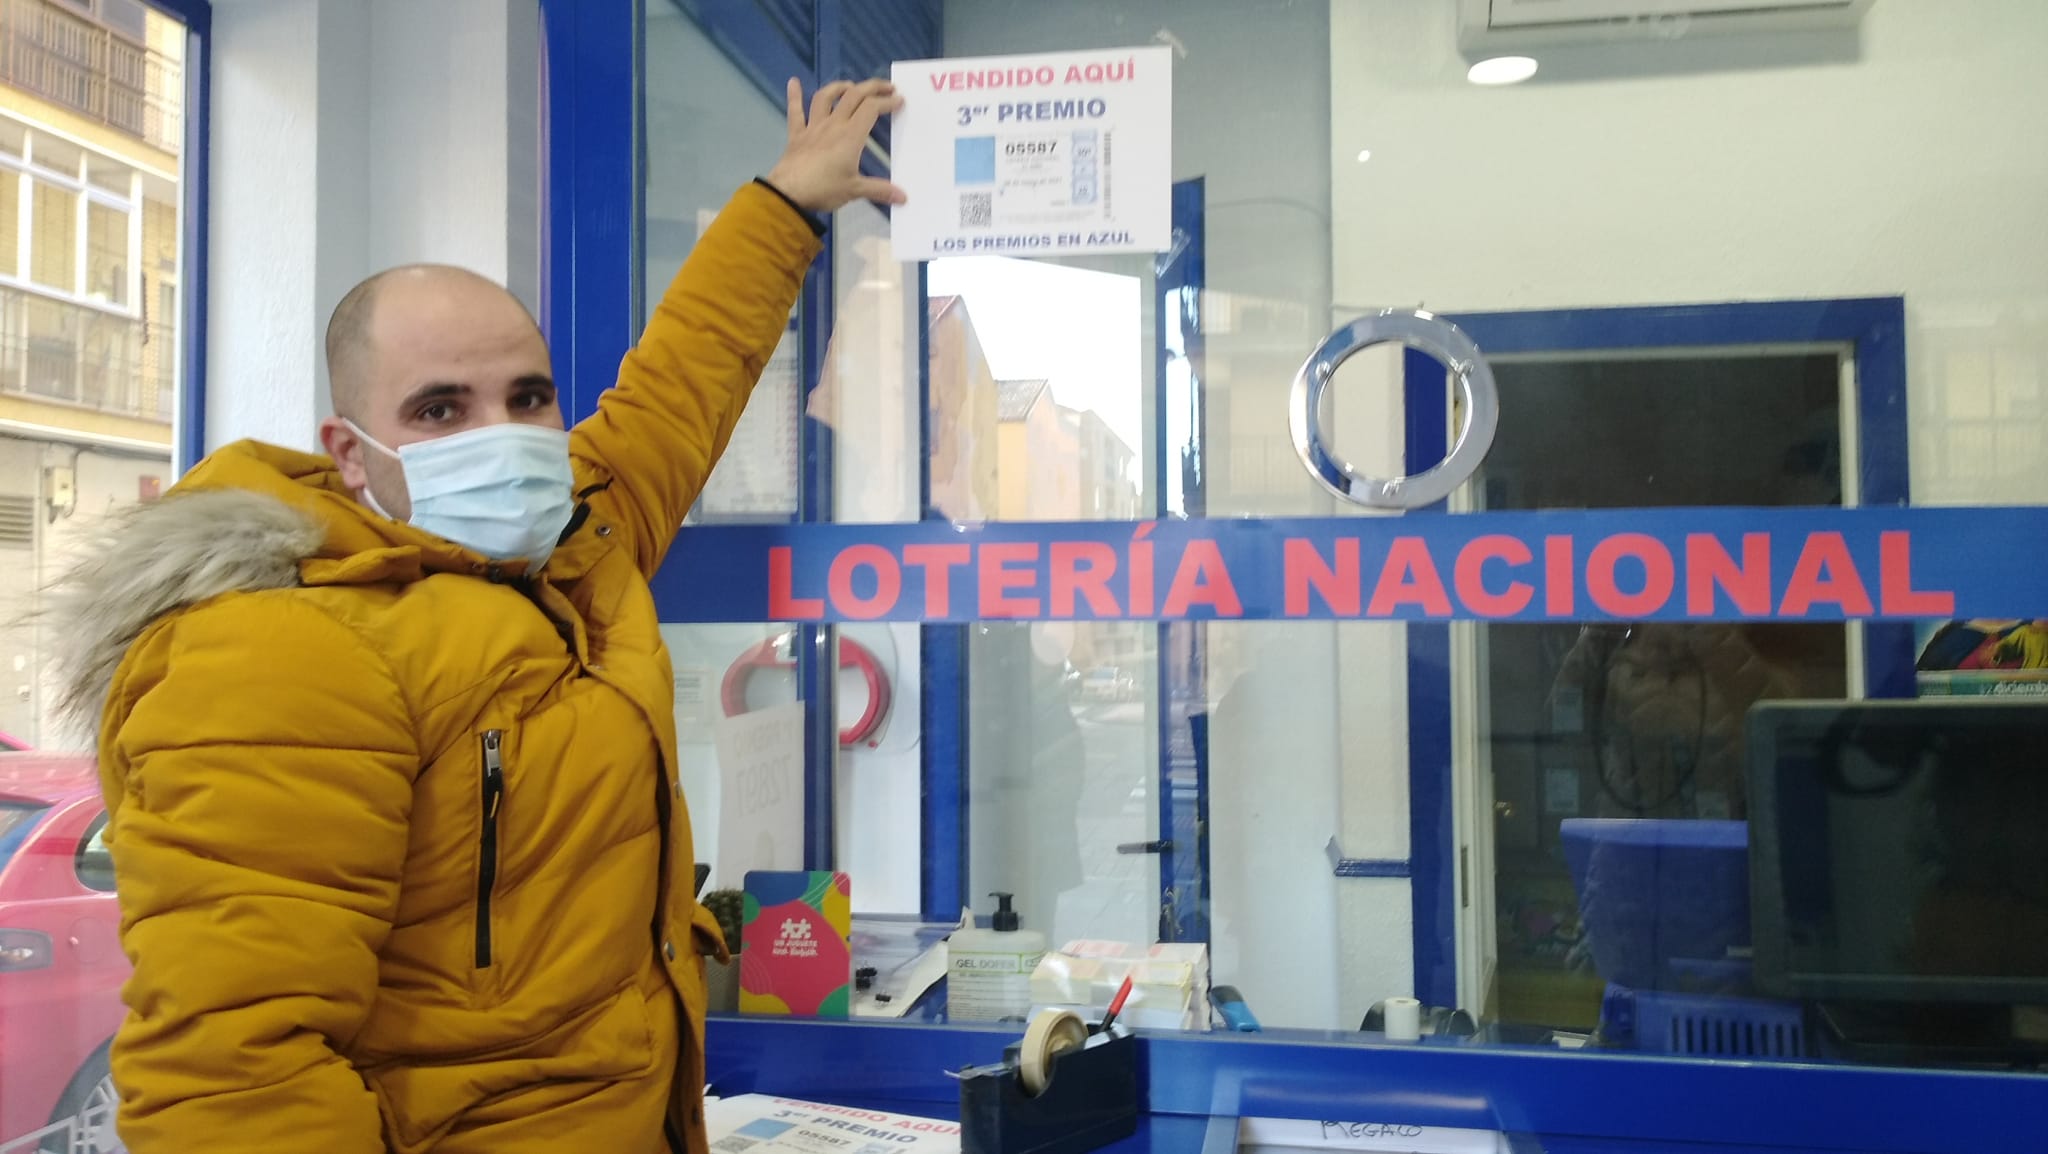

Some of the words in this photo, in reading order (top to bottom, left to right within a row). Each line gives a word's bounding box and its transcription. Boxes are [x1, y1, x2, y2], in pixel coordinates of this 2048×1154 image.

[930, 66, 1054, 92] VENDIDO
[1069, 57, 1135, 83] AQUÍ
[997, 98, 1107, 123] PREMIO
[1004, 141, 1058, 156] 05587
[933, 239, 967, 252] LOS
[972, 235, 1051, 250] PREMIOS
[1057, 233, 1081, 246] EN
[1086, 231, 1135, 246] AZUL
[768, 522, 1243, 620] LOTERÍA
[1284, 531, 1955, 619] NACIONAL
[956, 958, 977, 968] GEL
[773, 1099, 888, 1123] VENDIDO
[811, 1116, 918, 1144] PREMIO
